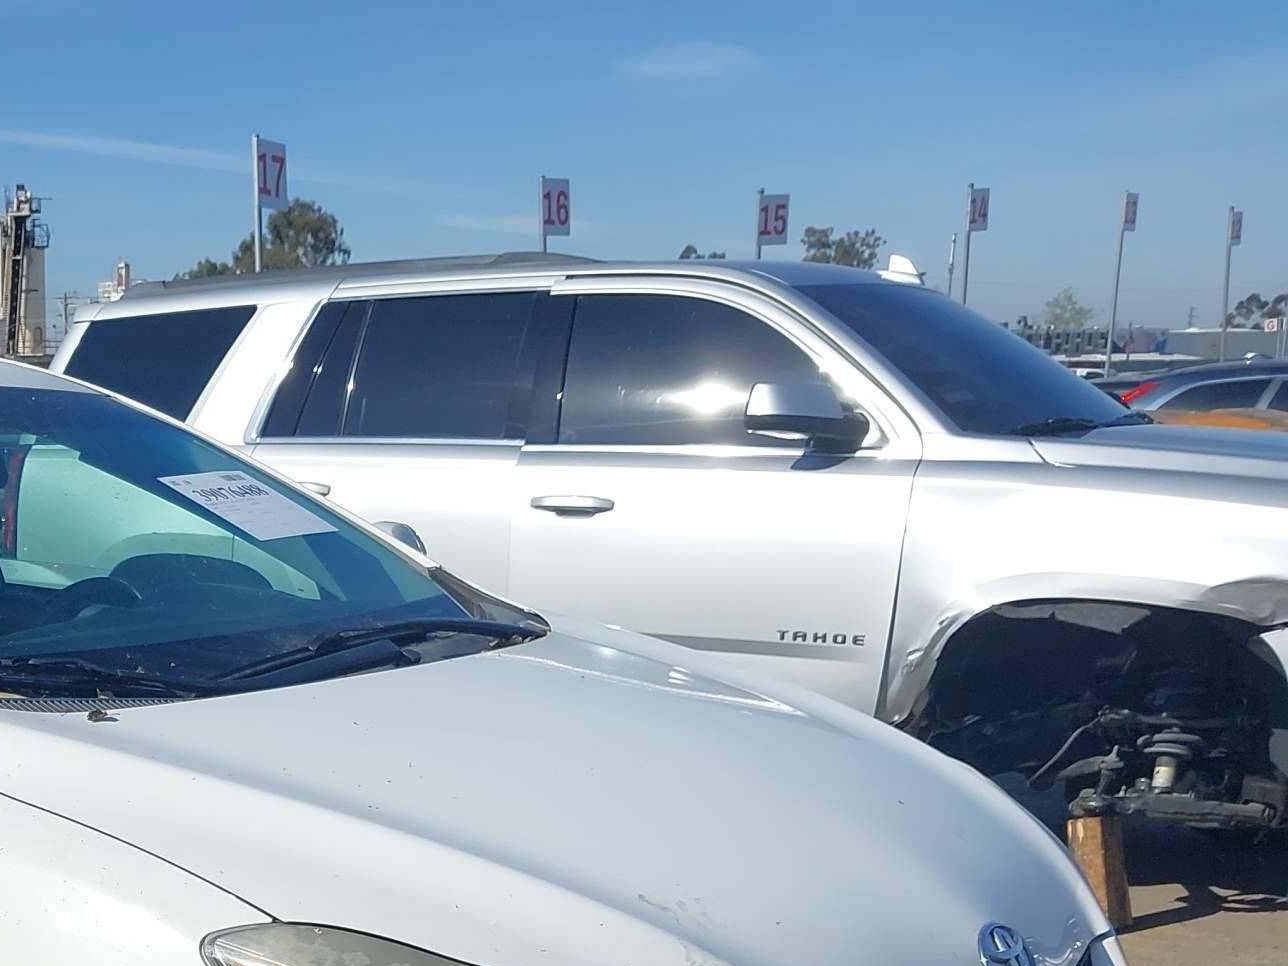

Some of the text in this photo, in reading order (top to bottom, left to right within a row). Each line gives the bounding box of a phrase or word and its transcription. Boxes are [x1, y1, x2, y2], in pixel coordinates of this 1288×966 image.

[258, 153, 285, 198] 17
[543, 190, 569, 226] 16
[759, 203, 787, 236] 15
[969, 197, 988, 225] 14
[191, 484, 271, 502] 39076488
[775, 629, 867, 647] TAHOE
